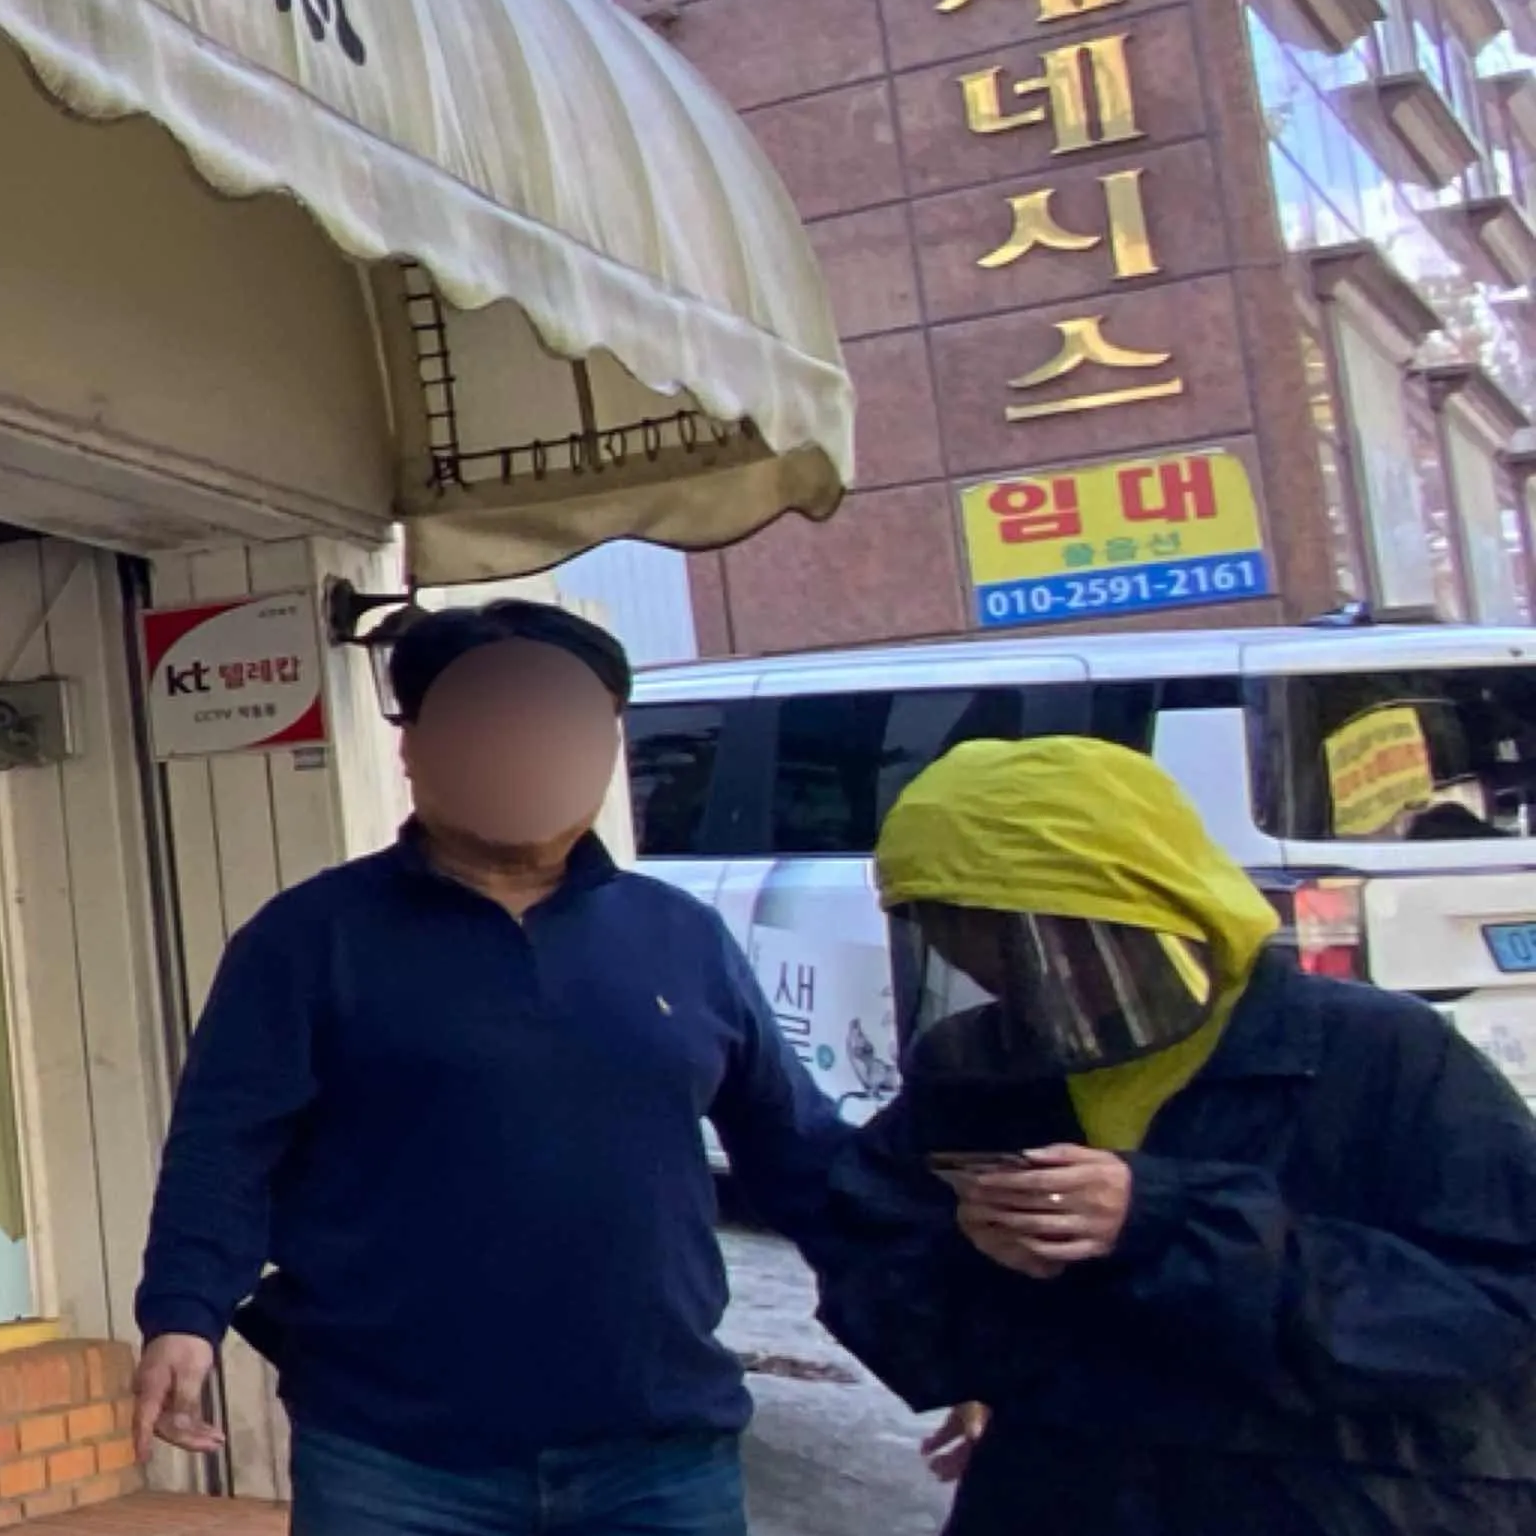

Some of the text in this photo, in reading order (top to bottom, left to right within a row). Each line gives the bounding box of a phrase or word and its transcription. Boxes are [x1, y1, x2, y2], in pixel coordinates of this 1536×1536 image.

[986, 560, 1256, 616] 010-2591-2161
[166, 656, 302, 696] kt 텔레캅
